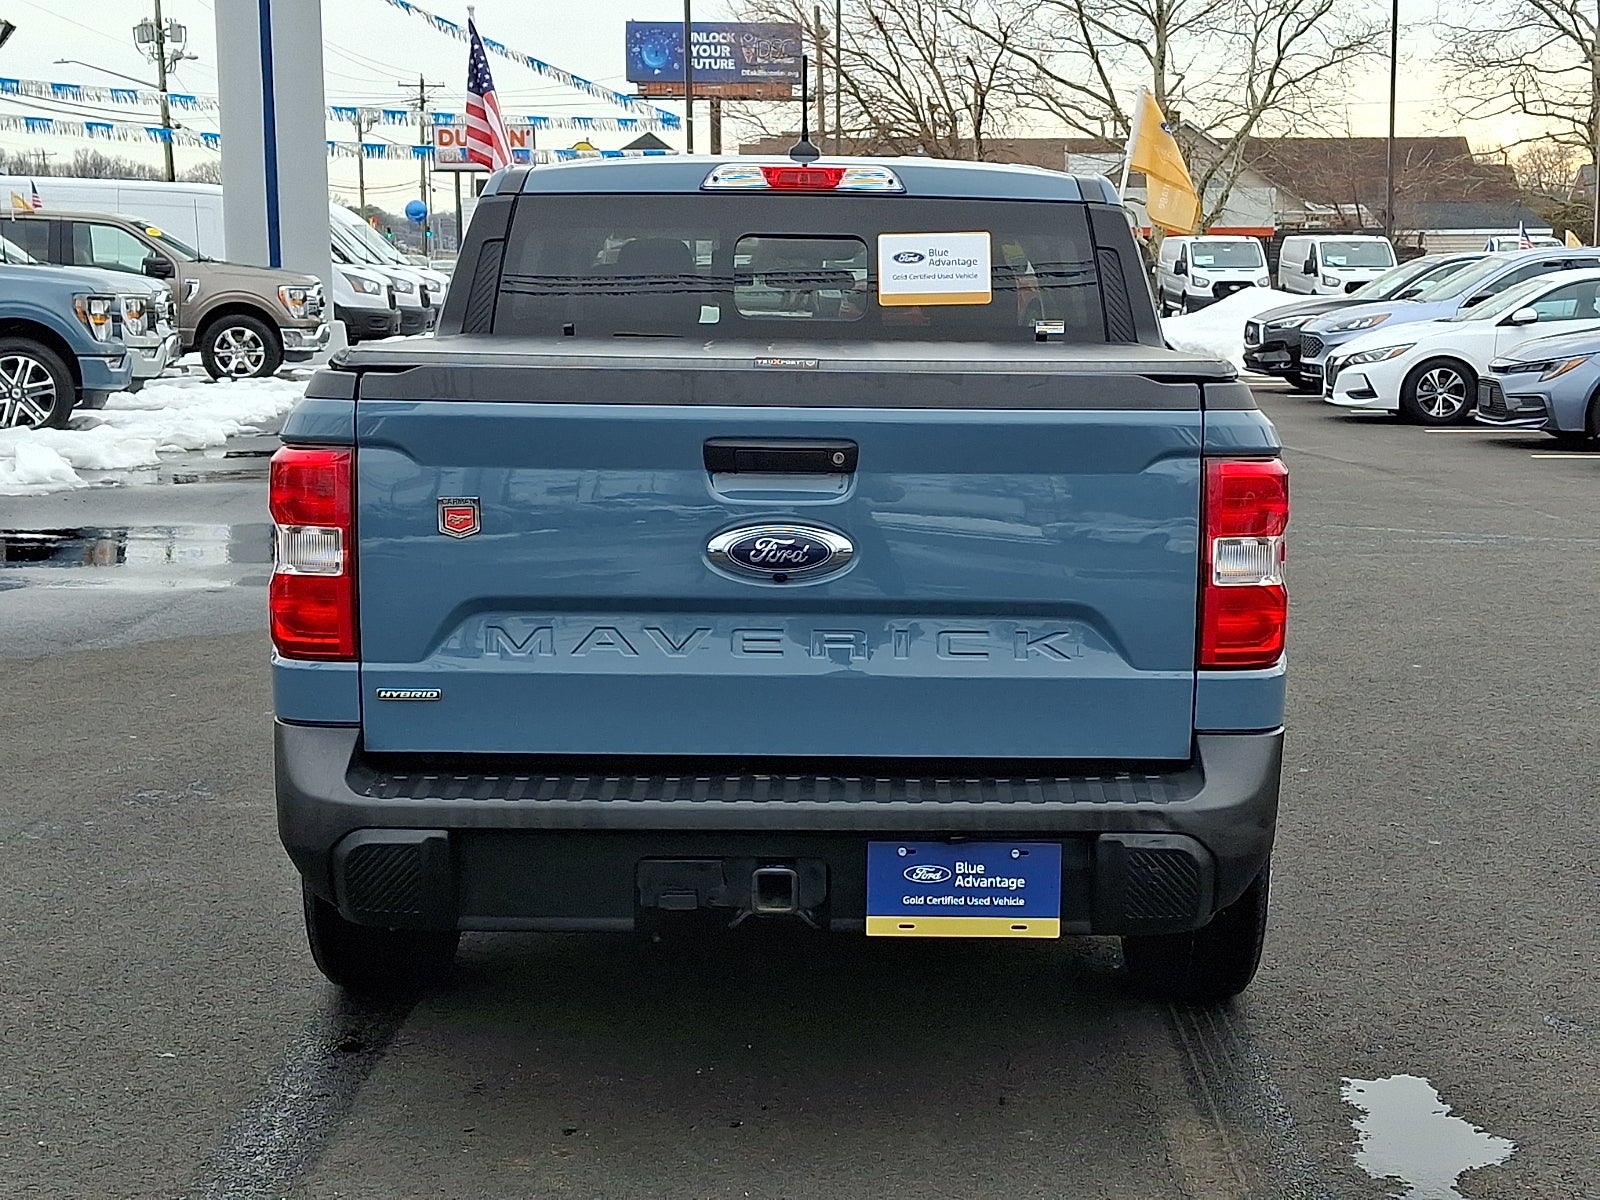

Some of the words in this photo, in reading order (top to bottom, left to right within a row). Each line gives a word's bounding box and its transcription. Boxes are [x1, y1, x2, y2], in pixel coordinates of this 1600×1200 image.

[690, 44, 731, 57] YOUR
[438, 129, 531, 147] DUN'
[928, 248, 950, 257] Blue
[928, 258, 979, 268] Advantage
[892, 273, 908, 281] Gold
[908, 273, 936, 281] Certified
[955, 272, 979, 280] Vehicle
[749, 537, 810, 563] Ford
[484, 624, 1072, 662] MAVERICK
[379, 690, 438, 698] HYBRID
[912, 867, 943, 880] Ford
[955, 861, 986, 874] Blue
[954, 875, 1026, 891] Advantage
[902, 895, 925, 905] Gold
[926, 895, 965, 906] Certified
[966, 896, 991, 906] Used
[992, 896, 1026, 906] Vehicle
